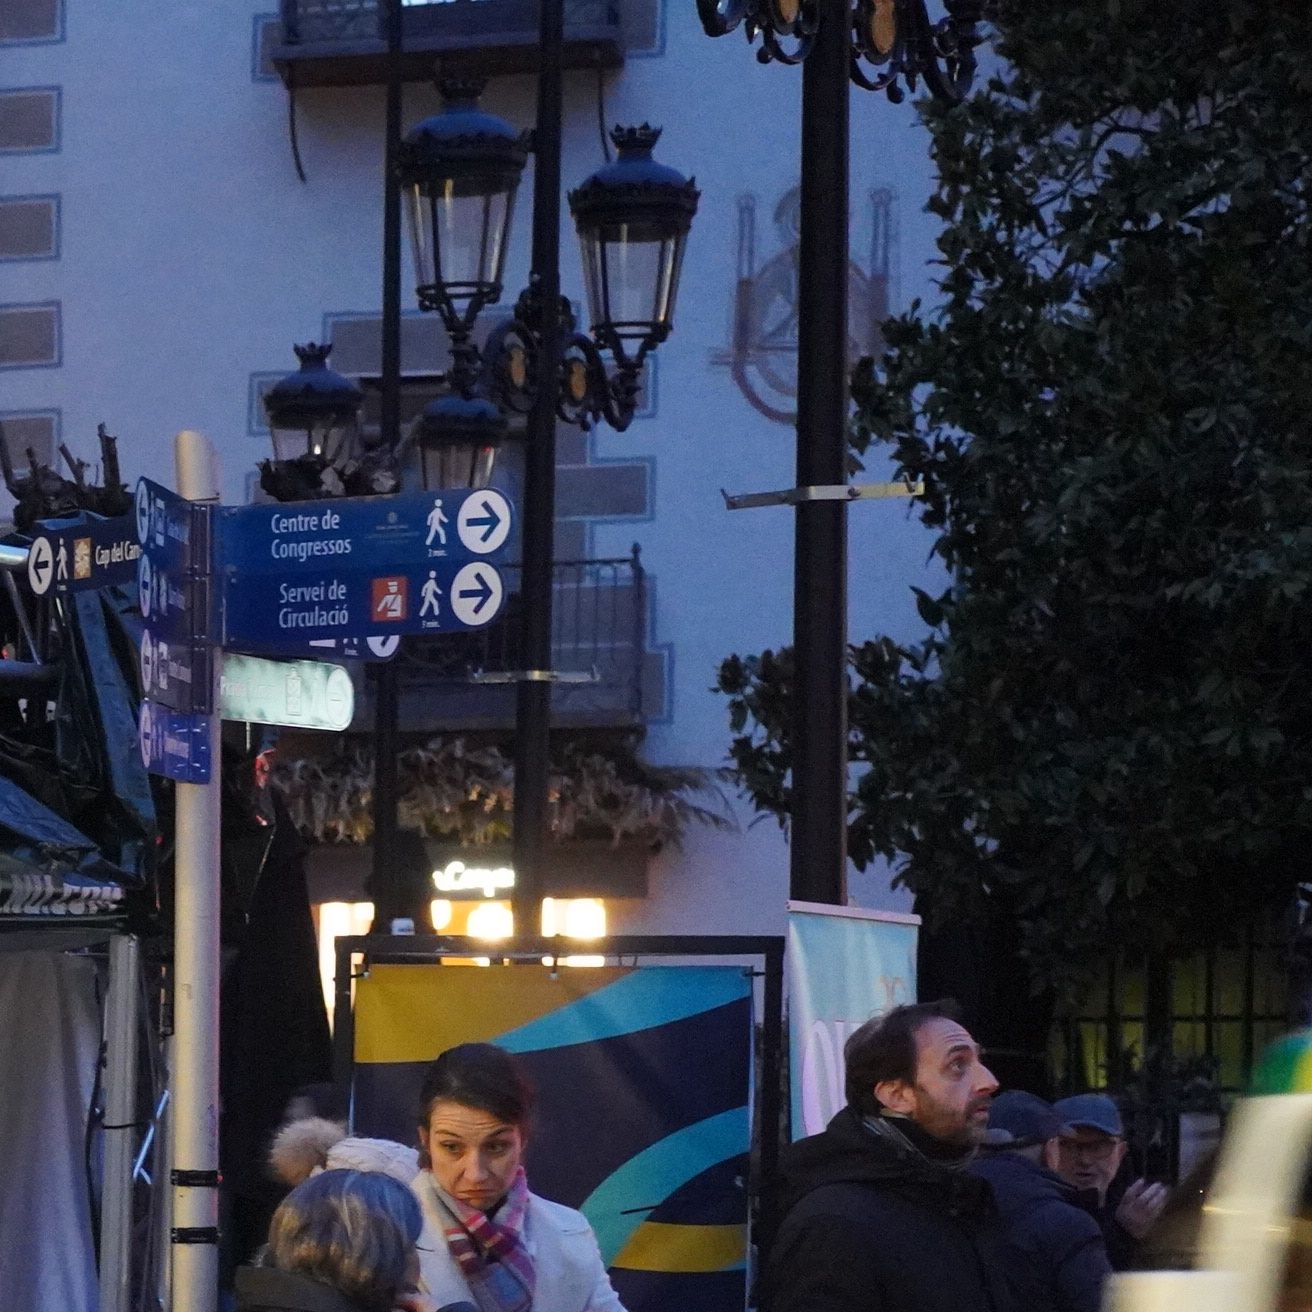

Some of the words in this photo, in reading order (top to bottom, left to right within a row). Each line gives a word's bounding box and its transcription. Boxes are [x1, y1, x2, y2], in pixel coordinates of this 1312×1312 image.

[271, 513, 318, 533] Centre
[321, 509, 340, 530] de
[271, 539, 352, 562] Congressos
[279, 582, 326, 604] Servei
[328, 579, 347, 600] de
[279, 604, 349, 628] Circulació
